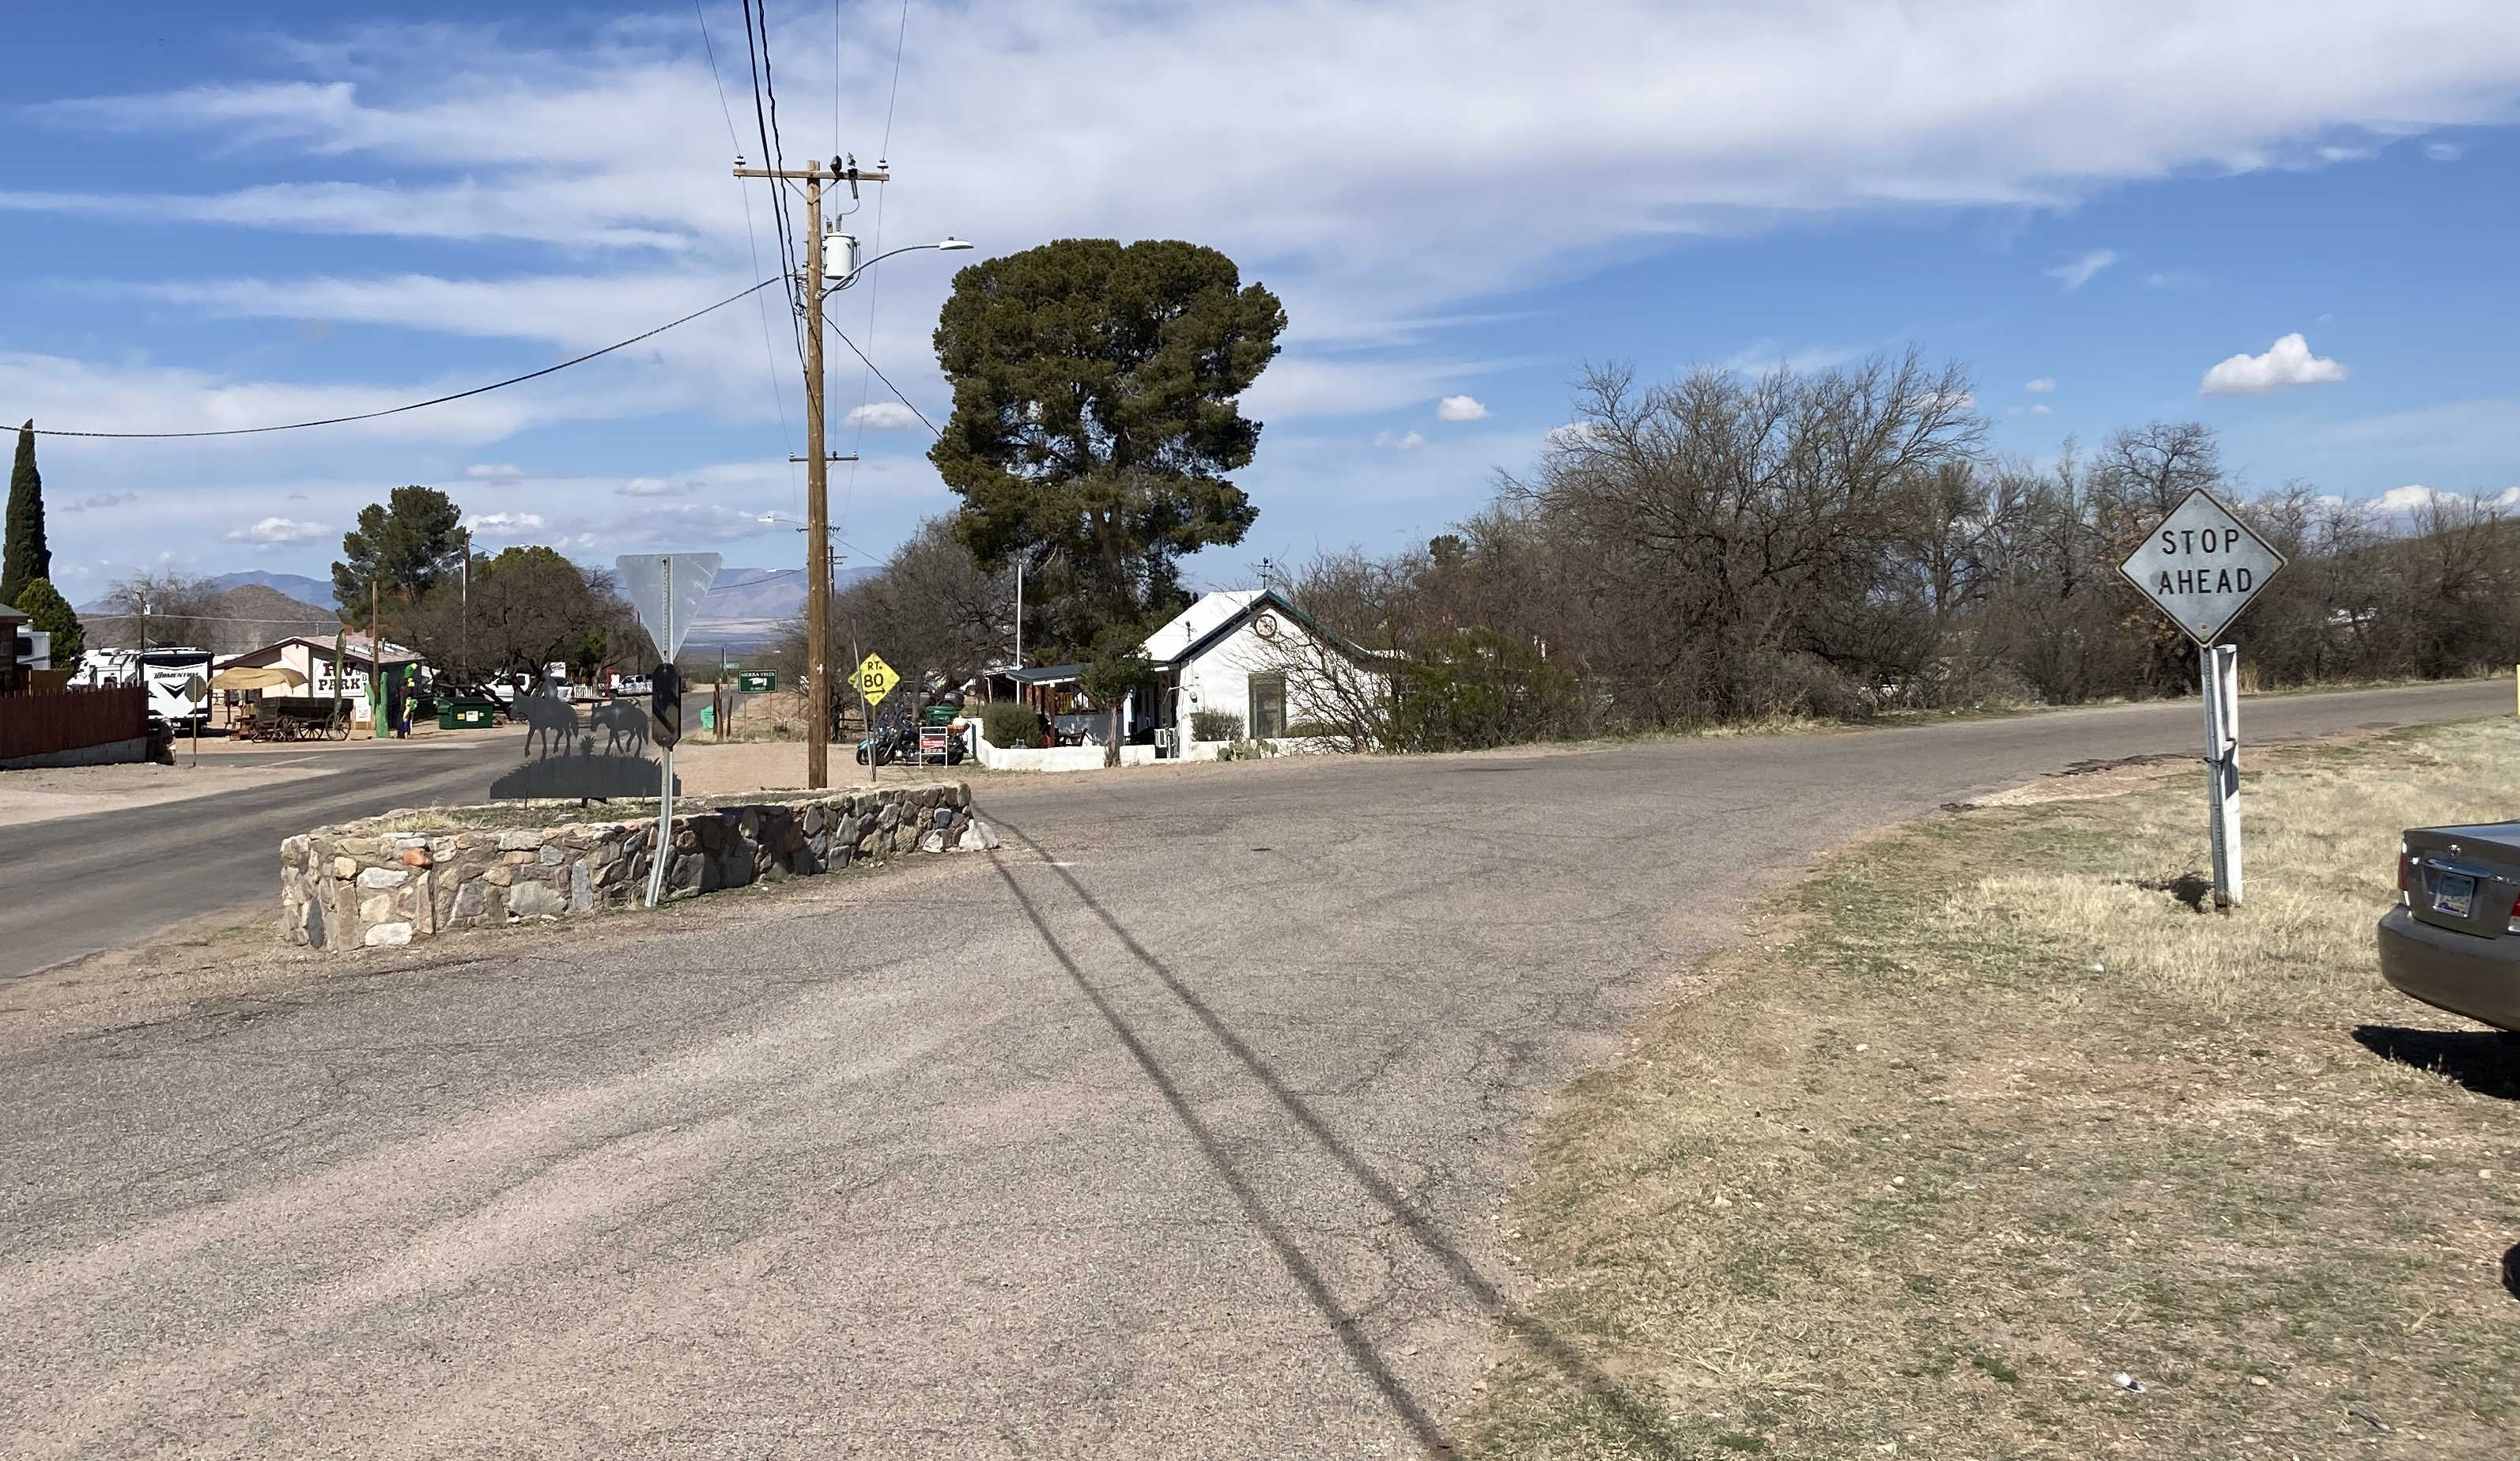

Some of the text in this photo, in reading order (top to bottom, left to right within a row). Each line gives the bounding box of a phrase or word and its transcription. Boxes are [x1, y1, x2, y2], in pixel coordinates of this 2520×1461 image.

[2162, 529, 2239, 555] STOP
[2159, 568, 2253, 595] AHEAD
[323, 662, 357, 676] RV
[867, 661, 882, 670] RT.
[318, 678, 360, 690] PARK
[864, 674, 884, 687] 80
